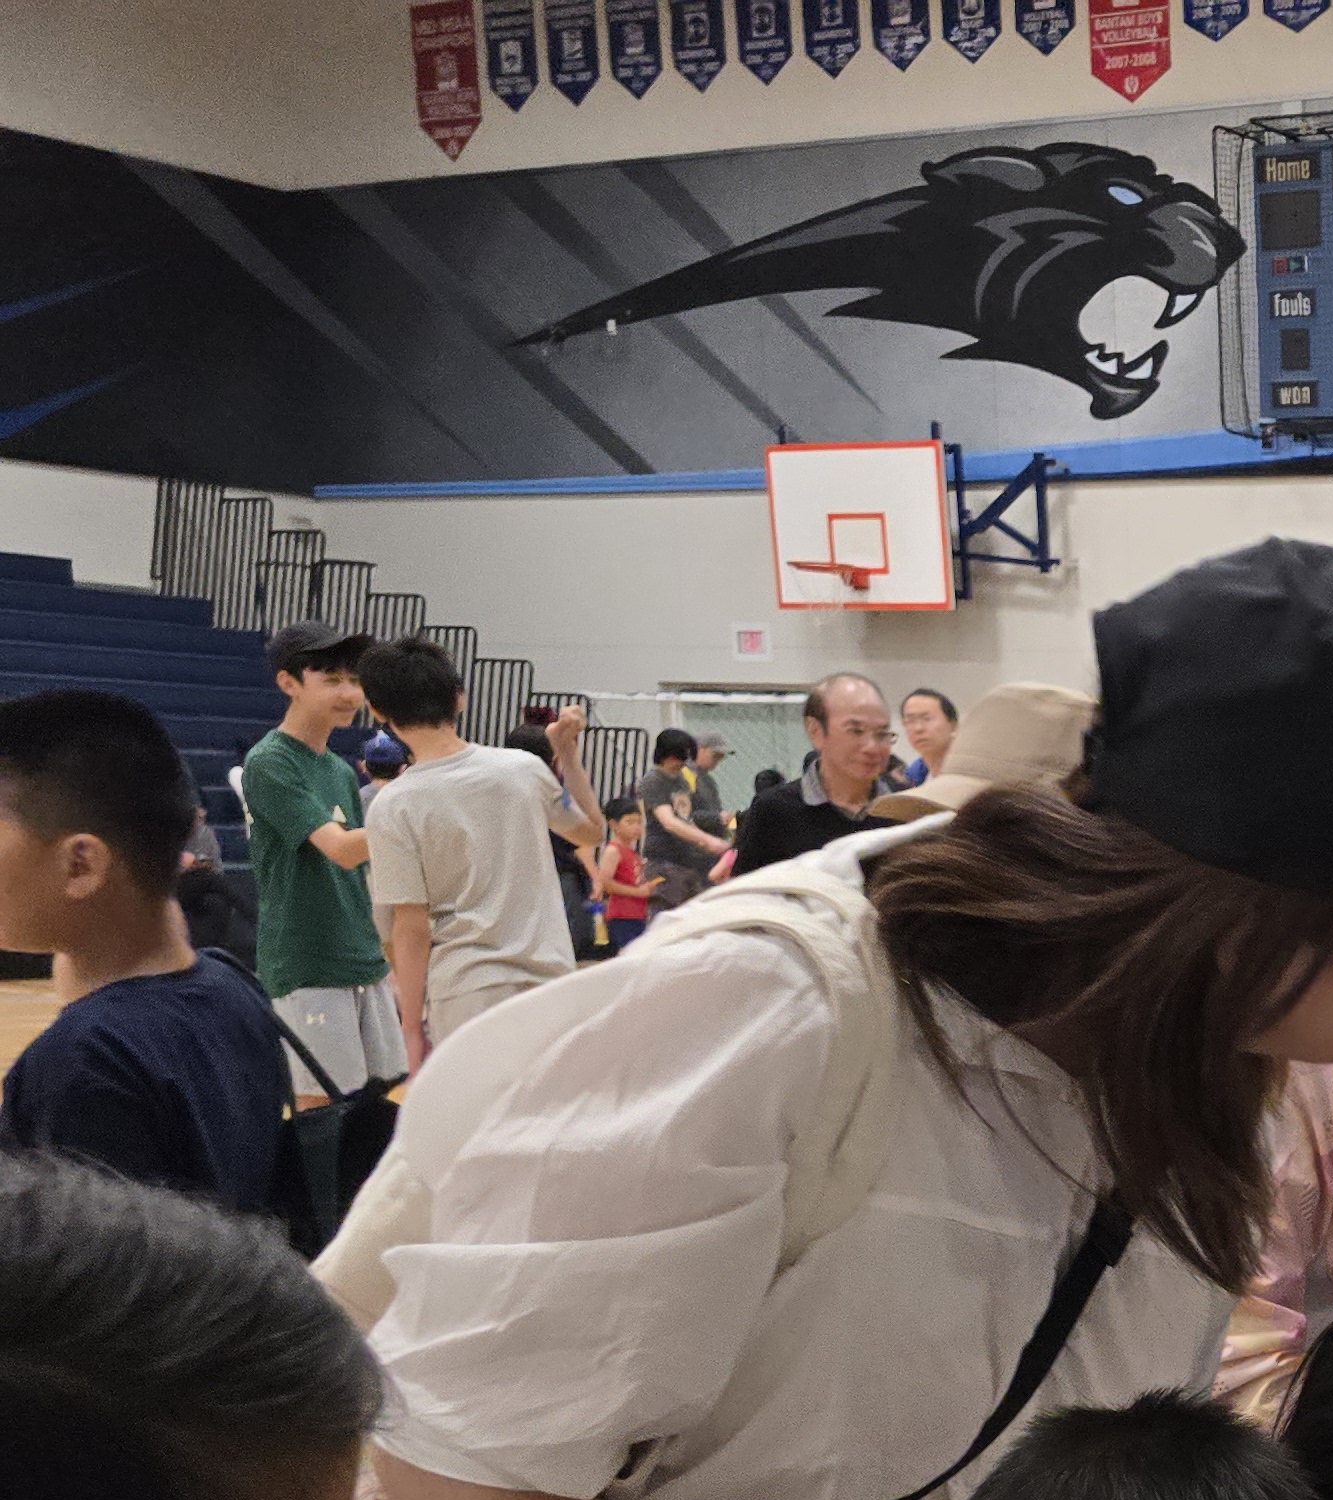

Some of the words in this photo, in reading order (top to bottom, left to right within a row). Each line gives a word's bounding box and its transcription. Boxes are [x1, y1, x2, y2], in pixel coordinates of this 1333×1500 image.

[1101, 27, 1158, 43] VOLLEYBALL
[1265, 157, 1311, 183] Home
[1273, 291, 1311, 317] fouls
[1280, 385, 1311, 406] won
